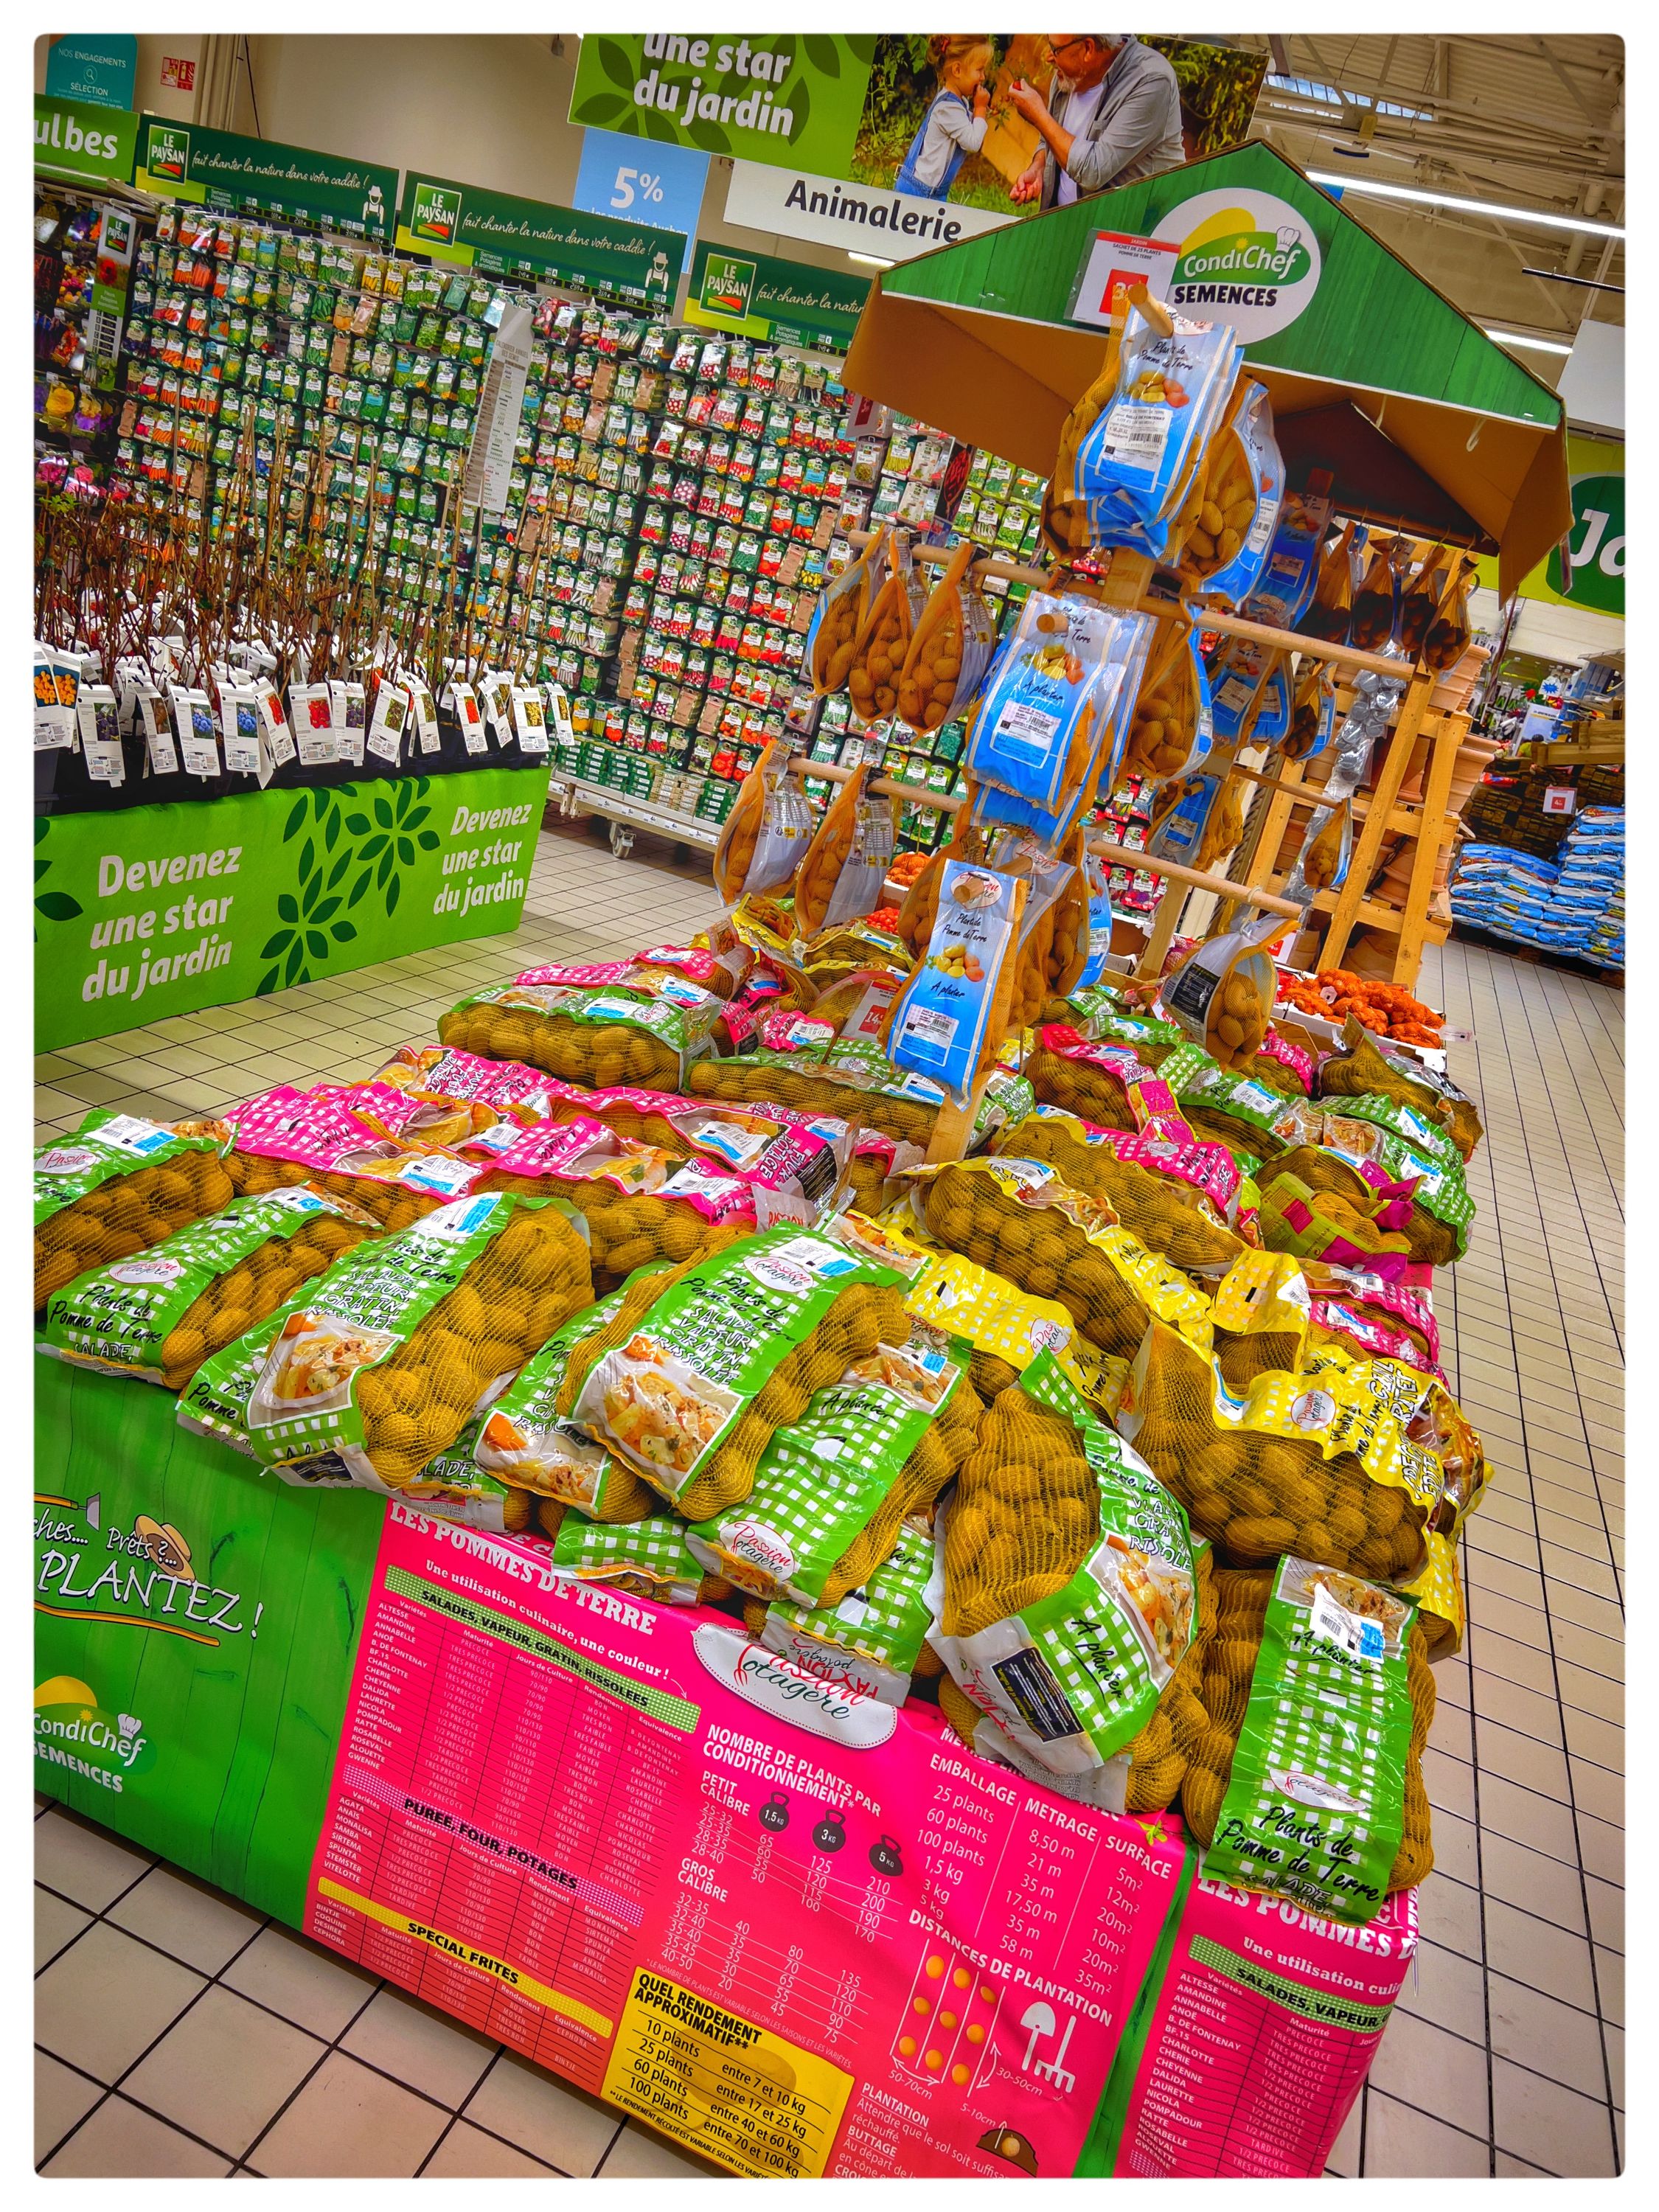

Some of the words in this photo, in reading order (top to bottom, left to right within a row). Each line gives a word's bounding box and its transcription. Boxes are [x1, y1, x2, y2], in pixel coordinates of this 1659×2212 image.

[58, 48, 73, 58] NOS
[74, 52, 126, 68] ENGAGEMENTS
[643, 34, 709, 67] une
[716, 38, 791, 83] star
[70, 82, 108, 96] SÉLECTION
[633, 69, 678, 111] du
[680, 77, 794, 136] jardin
[151, 145, 185, 164] PAYSAN
[164, 133, 174, 147] LE
[192, 150, 209, 168] fait
[209, 153, 243, 171] chanter
[243, 157, 253, 172] la
[255, 163, 284, 177] nature
[285, 165, 308, 181] dans
[310, 172, 329, 185] votre
[331, 172, 361, 189] caddie
[417, 204, 454, 225] PAYSAN
[431, 193, 443, 208] LE
[785, 179, 961, 243] Animalerie
[462, 212, 481, 230] fait
[481, 215, 518, 235] chanter
[519, 221, 530, 237] la
[532, 227, 563, 242] nature
[566, 230, 589, 247] dans
[591, 236, 613, 250] votre
[613, 237, 646, 254] caddie
[723, 263, 736, 279] LE
[1184, 244, 1301, 280] CondiChef
[707, 276, 748, 297] PAYSAN
[756, 283, 777, 302] fait
[777, 286, 818, 307] chanter
[819, 293, 831, 309] la
[1174, 285, 1278, 307] SEMENCES
[450, 802, 533, 837] Devenez
[97, 845, 243, 899] Devenez
[442, 851, 478, 876] une
[480, 838, 523, 869] star
[433, 883, 459, 916] du
[460, 874, 524, 917] jardin
[90, 911, 154, 950] une
[163, 893, 234, 933] star
[82, 959, 129, 1003] du
[131, 935, 233, 1001] jardin
[83, 1285, 129, 1312] Plants
[131, 1296, 150, 1318] de
[717, 1276, 766, 1307] Plants
[50, 1300, 93, 1329] Pomme
[94, 1312, 114, 1333] de
[119, 1317, 163, 1344] Terre
[837, 1394, 892, 1420] planter
[108, 1526, 153, 1560] Prêts
[389, 1502, 428, 1536] LES
[433, 1518, 534, 1584] POMMES
[538, 1560, 570, 1601] DE
[574, 1579, 658, 1635] TERRE
[37, 1549, 243, 1633] PLANTEZ
[377, 1612, 415, 1632] AMANDINE
[378, 1602, 409, 1620] ALTESSE
[425, 1559, 449, 1580] Une
[451, 1568, 517, 1609] utilisation
[518, 1599, 579, 1644] culinaire,
[580, 1635, 605, 1655] une
[607, 1646, 661, 1678] couleur
[375, 1621, 416, 1644] ANNABELLE
[421, 1590, 479, 1624] SALADES,
[481, 1615, 533, 1651] VAPEUR,
[535, 1641, 583, 1674] GRATIN,
[585, 1665, 649, 1708] RISSOLEES
[367, 1657, 408, 1679] CHARLOTTE
[1078, 1644, 1123, 1699] planter
[1309, 1641, 1373, 1674] planter
[358, 1700, 386, 1716] NICOLA
[361, 1691, 396, 1711] LAURETTE
[357, 1708, 402, 1733] POMPADOUR
[703, 1770, 737, 1795] PETIT
[707, 1724, 773, 1761] NOMBRE
[774, 1750, 796, 1769] DE
[797, 1759, 853, 1798] PLANTS
[854, 1790, 882, 1818] PAR
[700, 1783, 750, 1817] CALIBRE
[929, 1753, 1018, 1806] EMBALLAGE
[1024, 1797, 1099, 1843] METRAGE
[1105, 1834, 1172, 1879] SURFACE
[335, 1815, 372, 1838] MONALISA
[933, 1784, 950, 1802] 25
[953, 1793, 995, 1823] plants
[1029, 1829, 1060, 1854] 8,50
[1060, 1846, 1076, 1860] m
[1258, 1806, 1326, 1845] Plants
[1331, 1832, 1354, 1857] de
[405, 1798, 456, 1832] PUREE,
[459, 1823, 504, 1855] FOUR,
[507, 1846, 578, 1890] POTAGES
[691, 1840, 724, 1864] 28-40
[1217, 1819, 1280, 1866] Pomme
[1287, 1848, 1311, 1874] de
[1321, 1854, 1380, 1903] Terre
[324, 1860, 361, 1884] VITELOTTE
[681, 1857, 715, 1881] GROS
[866, 1876, 891, 1895] 210
[924, 1855, 943, 1875] 1,5
[945, 1864, 964, 1885] kg
[677, 1870, 728, 1903] CALIBRE
[408, 1922, 466, 1959] SPECIAL
[469, 1952, 519, 1984] FRITES
[908, 1908, 988, 1968] DISTANCES
[990, 1958, 1012, 1979] DE
[1014, 1966, 1113, 2028] PLANTATION
[1243, 1936, 1273, 1959] Une
[1277, 1950, 1365, 1991] utilisation
[1236, 1968, 1312, 2012] SALADES,
[639, 1973, 674, 2001] QUEL
[677, 1992, 762, 2045] RENDEMENT
[639, 2037, 654, 2054] 25
[655, 2046, 694, 2077] plants
[629, 2076, 651, 2096] 100
[652, 2090, 689, 2120] plants
[888, 2069, 933, 2100] 50-70cm
[996, 2066, 1043, 2096] 30-50cm
[862, 2082, 929, 2128] PLANTATION
[847, 2125, 897, 2157] BUTTAGE
